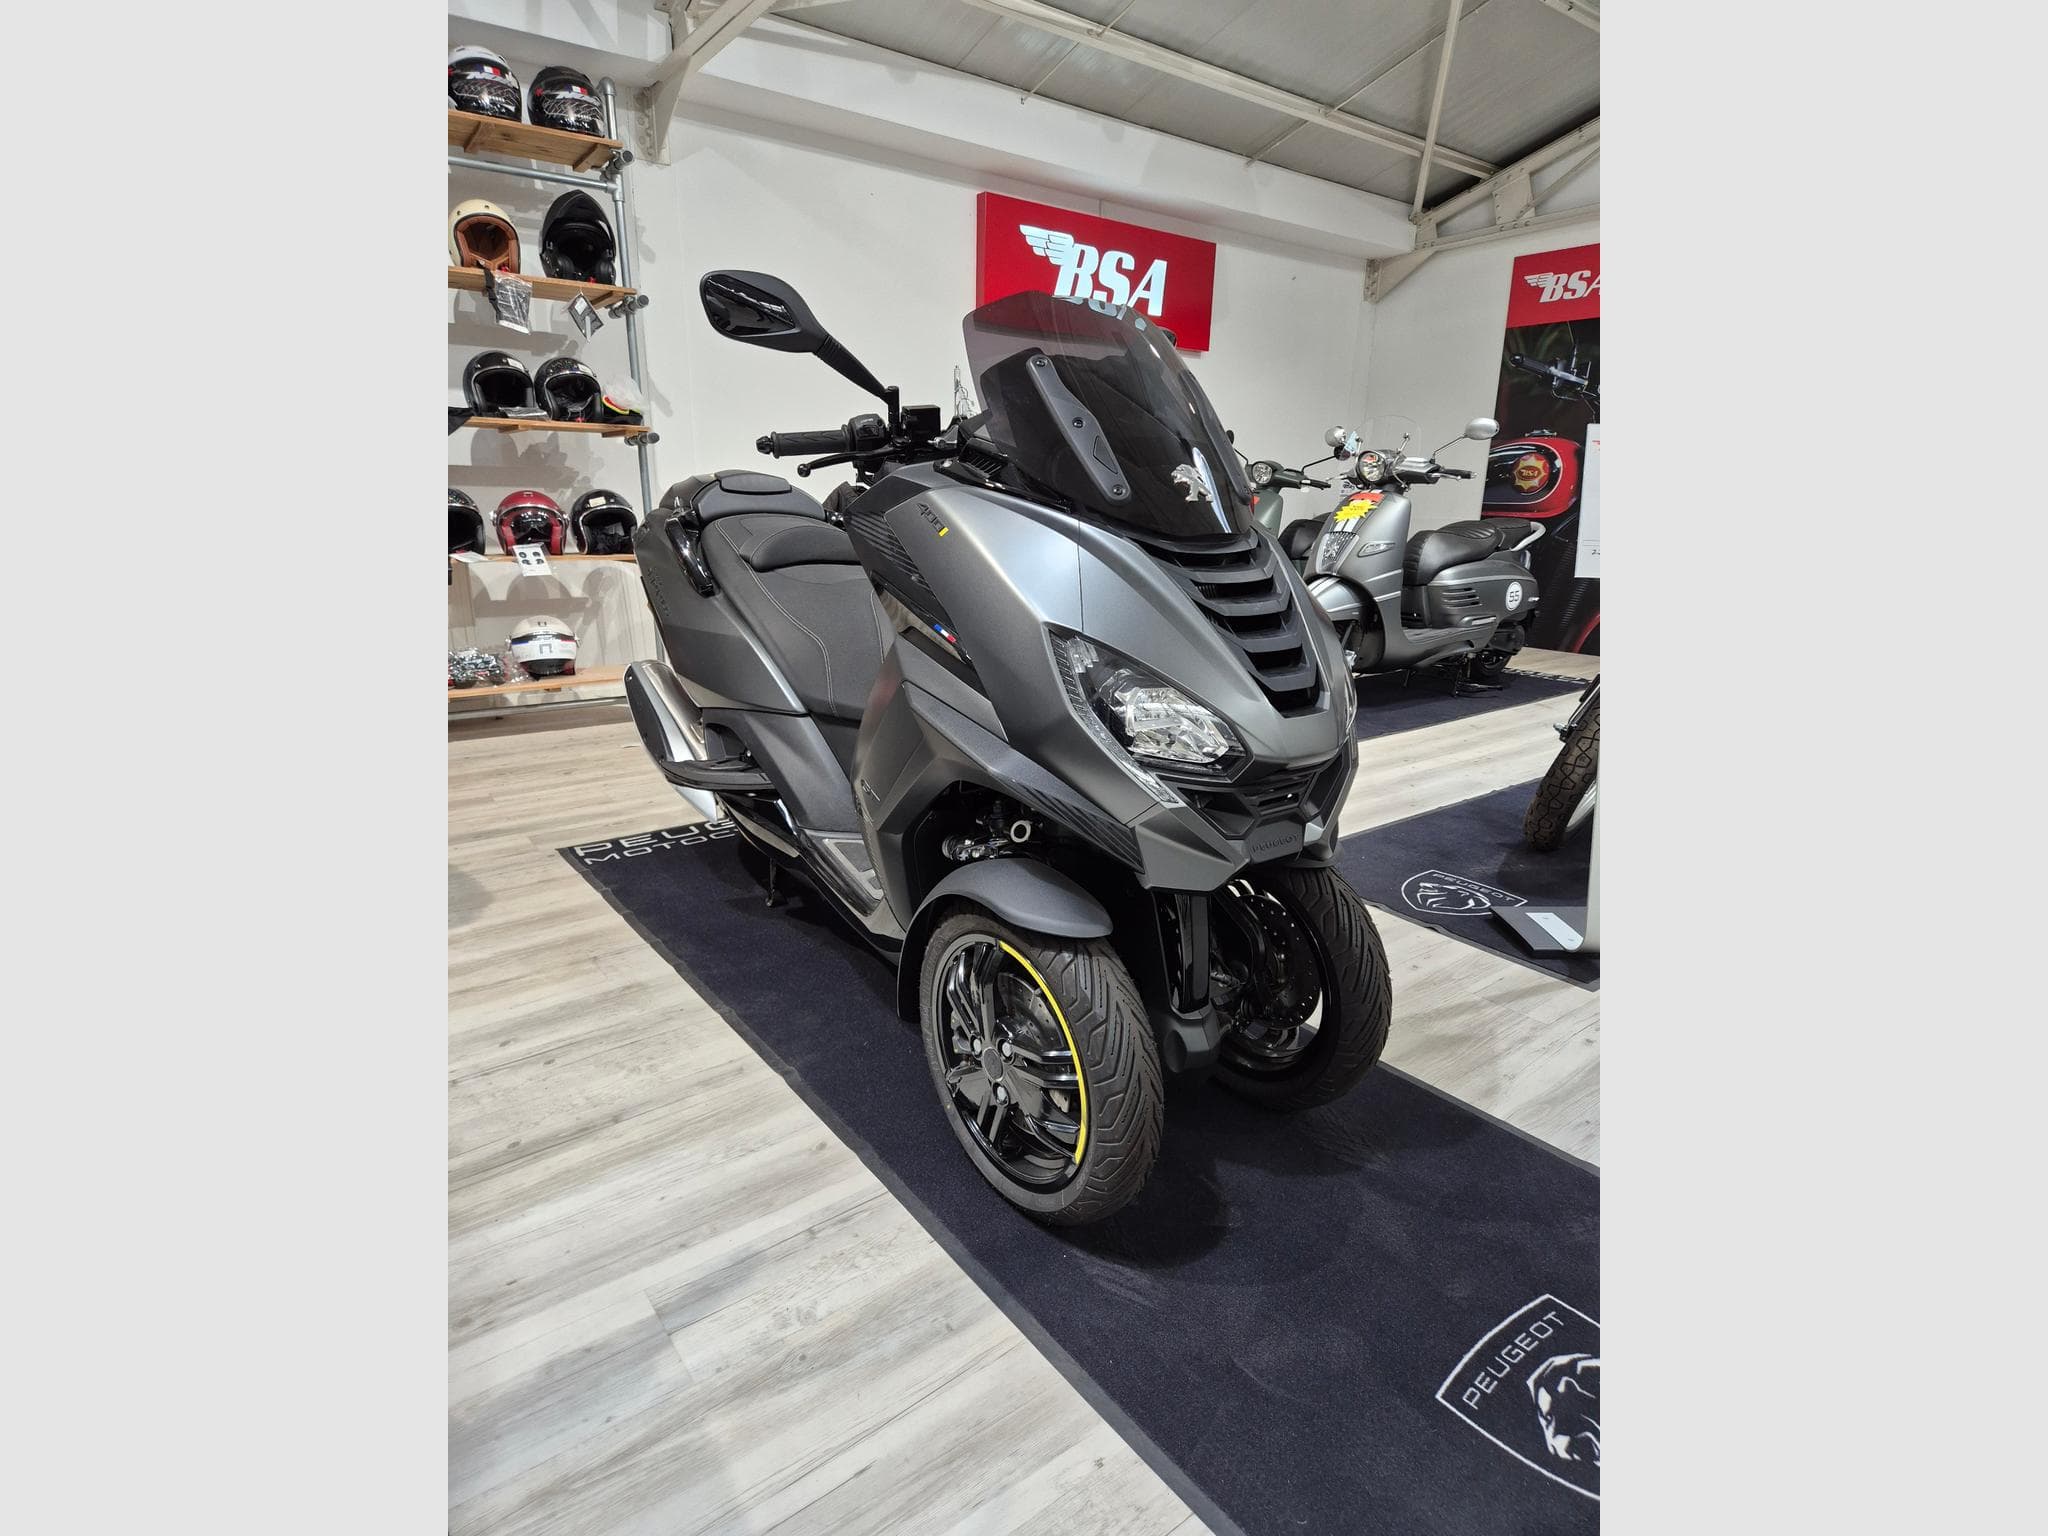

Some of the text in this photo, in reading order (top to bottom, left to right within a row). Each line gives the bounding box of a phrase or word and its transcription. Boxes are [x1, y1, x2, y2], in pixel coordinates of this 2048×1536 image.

[1052, 242, 1168, 318] BSA
[1520, 468, 1539, 478] BSA
[917, 503, 945, 533] 400
[1508, 590, 1520, 603] 55
[584, 828, 739, 865] MOTOC
[1251, 833, 1299, 854] PEUGEOT
[1432, 873, 1516, 901] PEUGEOT
[1462, 1310, 1565, 1411] PEUGEOT
